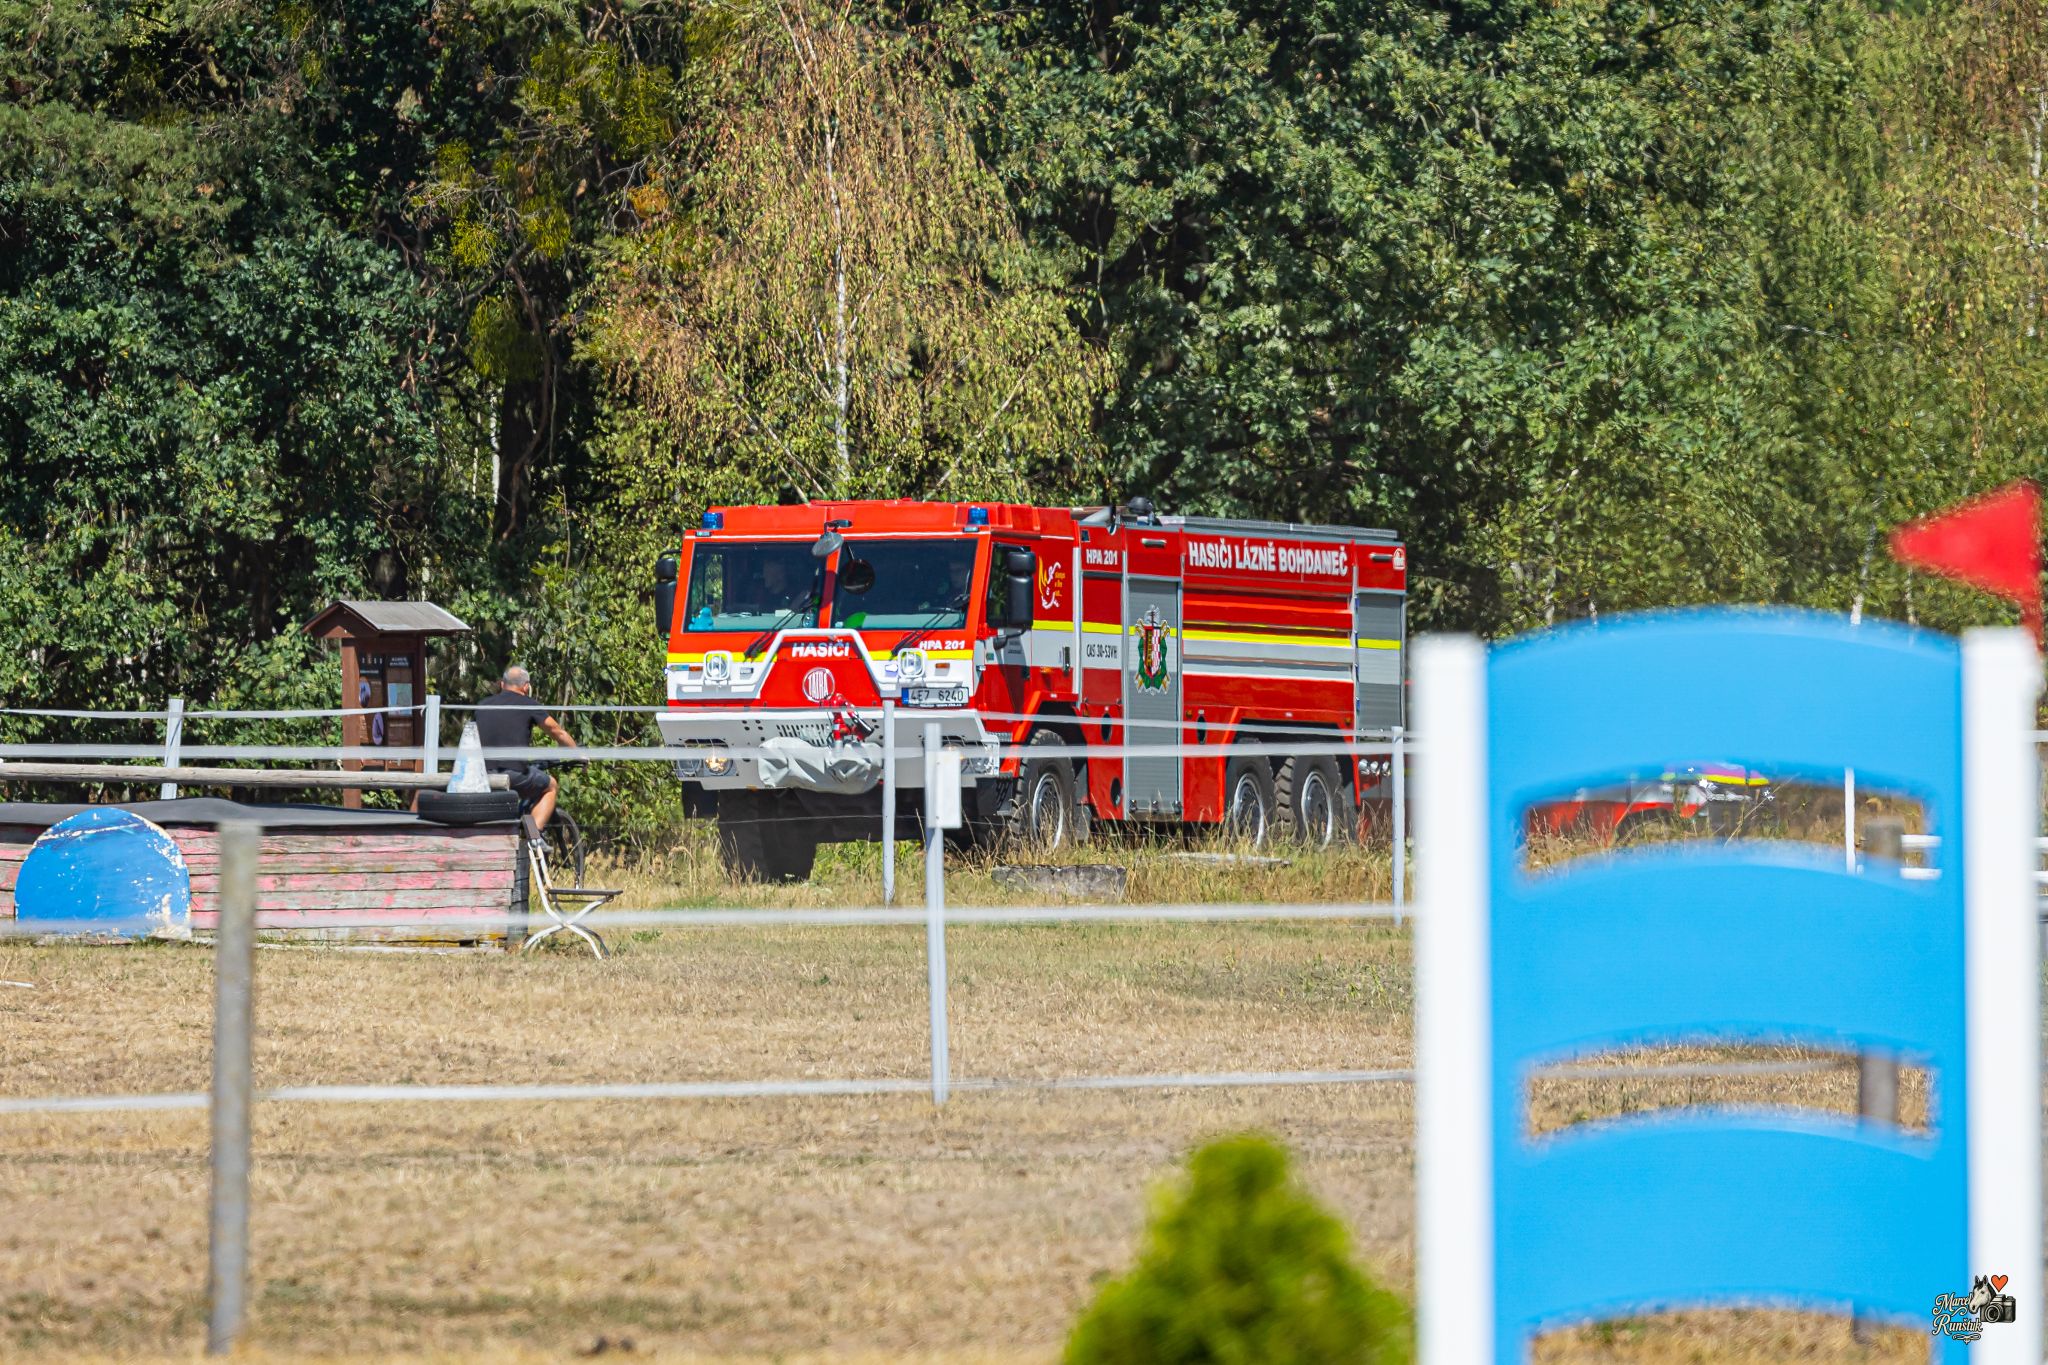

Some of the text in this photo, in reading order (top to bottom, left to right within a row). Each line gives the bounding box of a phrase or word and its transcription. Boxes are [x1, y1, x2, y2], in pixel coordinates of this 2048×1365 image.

[1086, 549, 1118, 565] HPA 201
[1188, 537, 1348, 577] HASIČI LÁZNĚ BOHDANEČ
[791, 639, 850, 658] HASIČI
[919, 640, 966, 650] HPA 201
[911, 689, 964, 702] 4E7 6240
